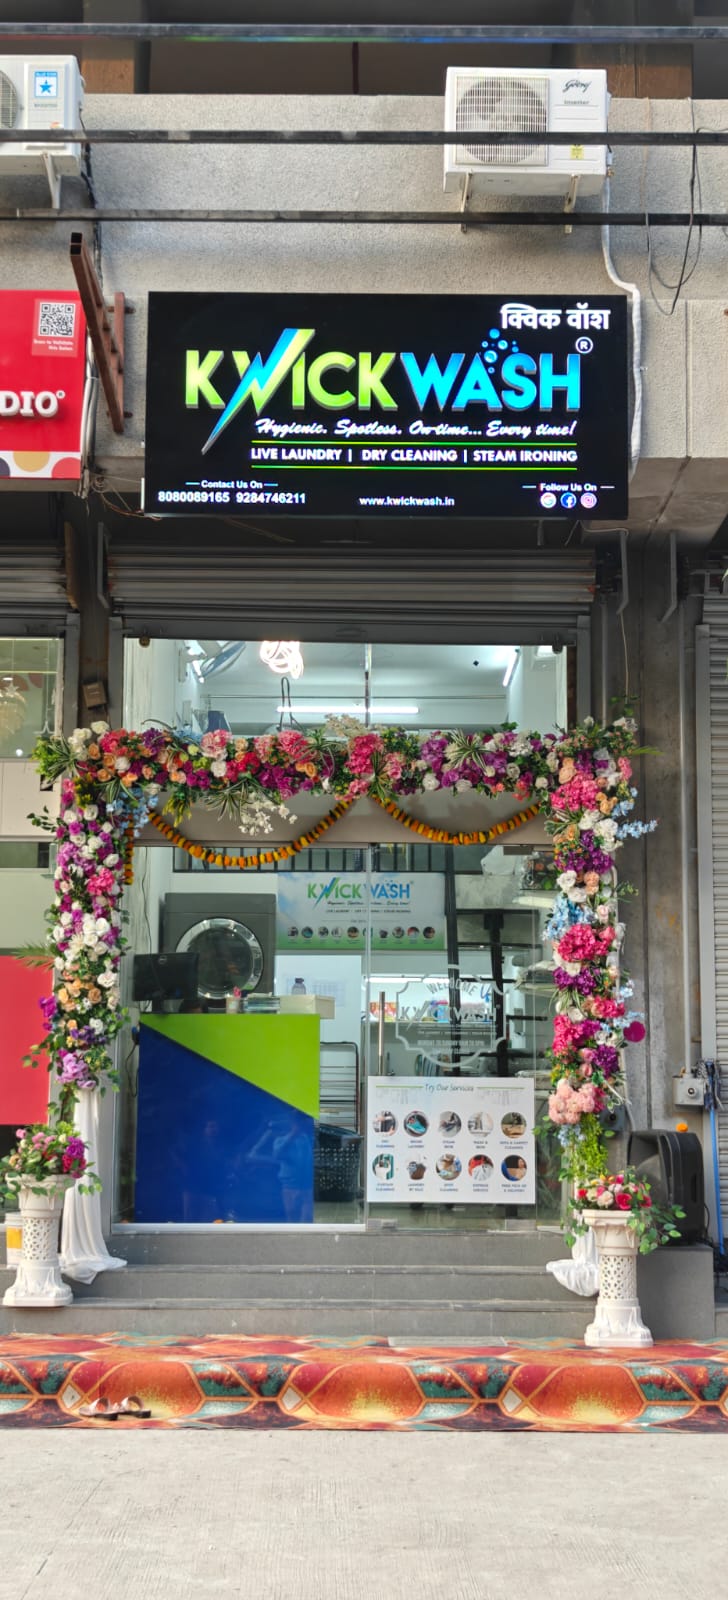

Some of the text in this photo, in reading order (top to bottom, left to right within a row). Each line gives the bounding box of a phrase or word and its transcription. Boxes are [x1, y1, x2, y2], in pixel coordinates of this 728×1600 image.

[500, 302, 611, 329] क्विक वॉश
[255, 418, 327, 438] Hygienic.
[334, 418, 402, 438] Spotless.
[486, 420, 531, 439] Every
[535, 420, 577, 436] time!
[251, 448, 279, 460] LIVE
[281, 448, 342, 461] LAUNDRY
[362, 450, 388, 461] DRY
[391, 450, 458, 462] CLEANING
[473, 450, 517, 462] STEAM
[520, 450, 578, 462] IRONING
[201, 480, 263, 489] Contact Us On
[540, 483, 598, 492] Follow Us On
[158, 491, 306, 504] 8080089165 9284746211
[359, 494, 455, 507] www.kwickwash.in
